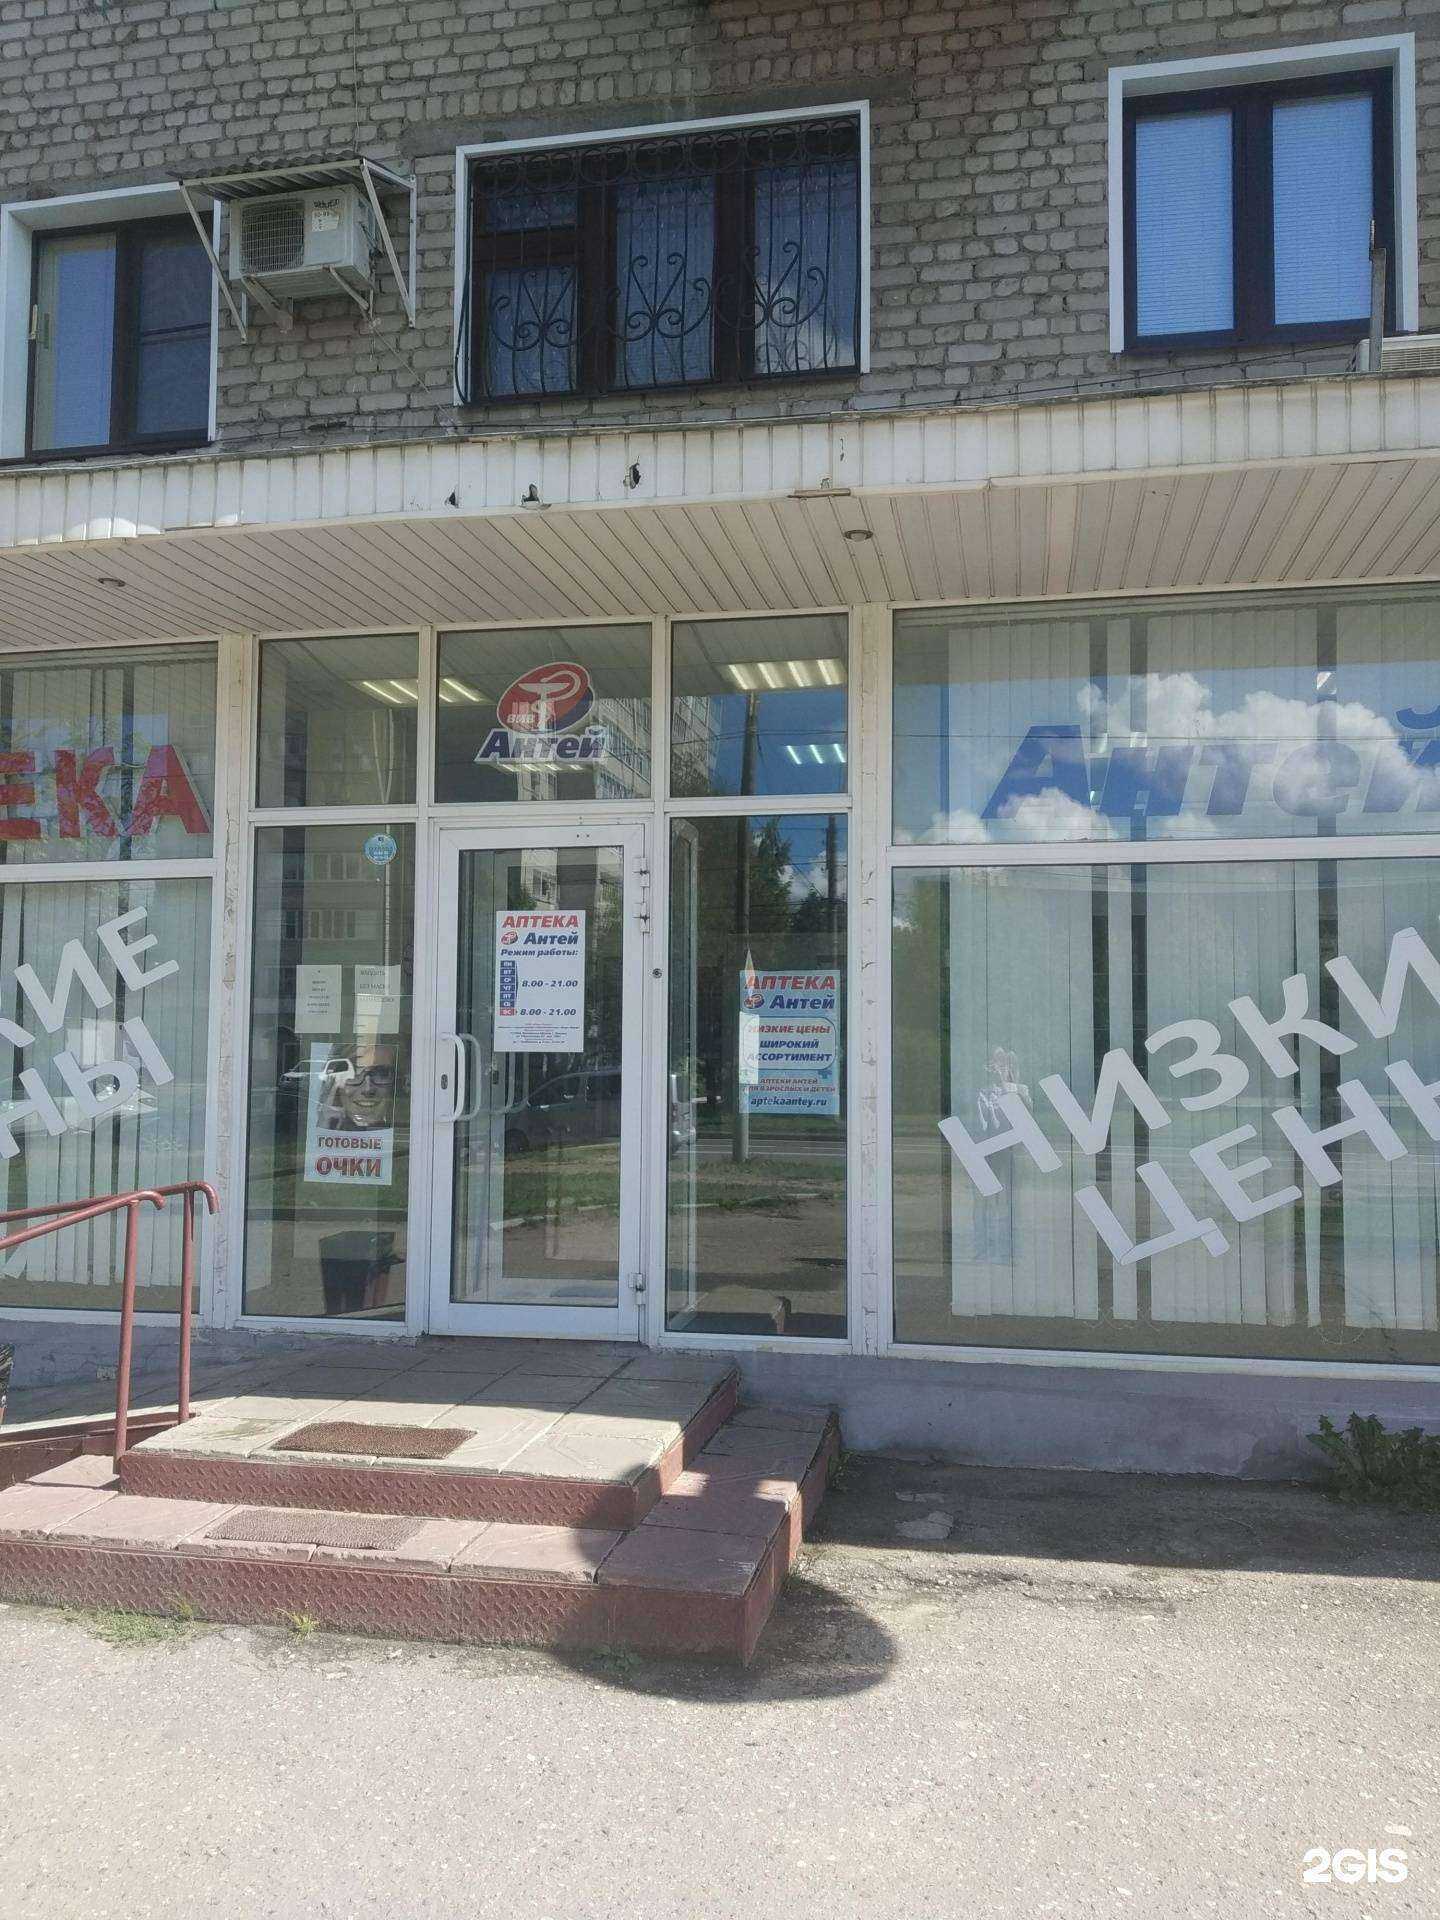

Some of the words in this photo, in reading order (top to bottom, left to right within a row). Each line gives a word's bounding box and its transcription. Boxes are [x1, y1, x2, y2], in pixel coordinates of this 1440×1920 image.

[477, 728, 606, 759] Антей
[981, 704, 1440, 819] Антей
[502, 915, 579, 928] АПТЕКА
[523, 931, 579, 945] Антей
[537, 948, 578, 957] работы:
[0, 906, 179, 1049] ИЕ
[745, 976, 835, 989] АПТЕКА
[769, 995, 835, 1009] Антей
[520, 1008, 542, 1016] 8.00
[548, 1008, 577, 1016] 21.00
[796, 1025, 831, 1034] ЦЕНЫ
[759, 1039, 820, 1049] ШИРОКИЙ
[750, 1096, 827, 1107] aptekaantey.ru
[318, 1136, 382, 1149] ГОТОВЫЕ
[315, 1157, 382, 1177] ОЧКИ
